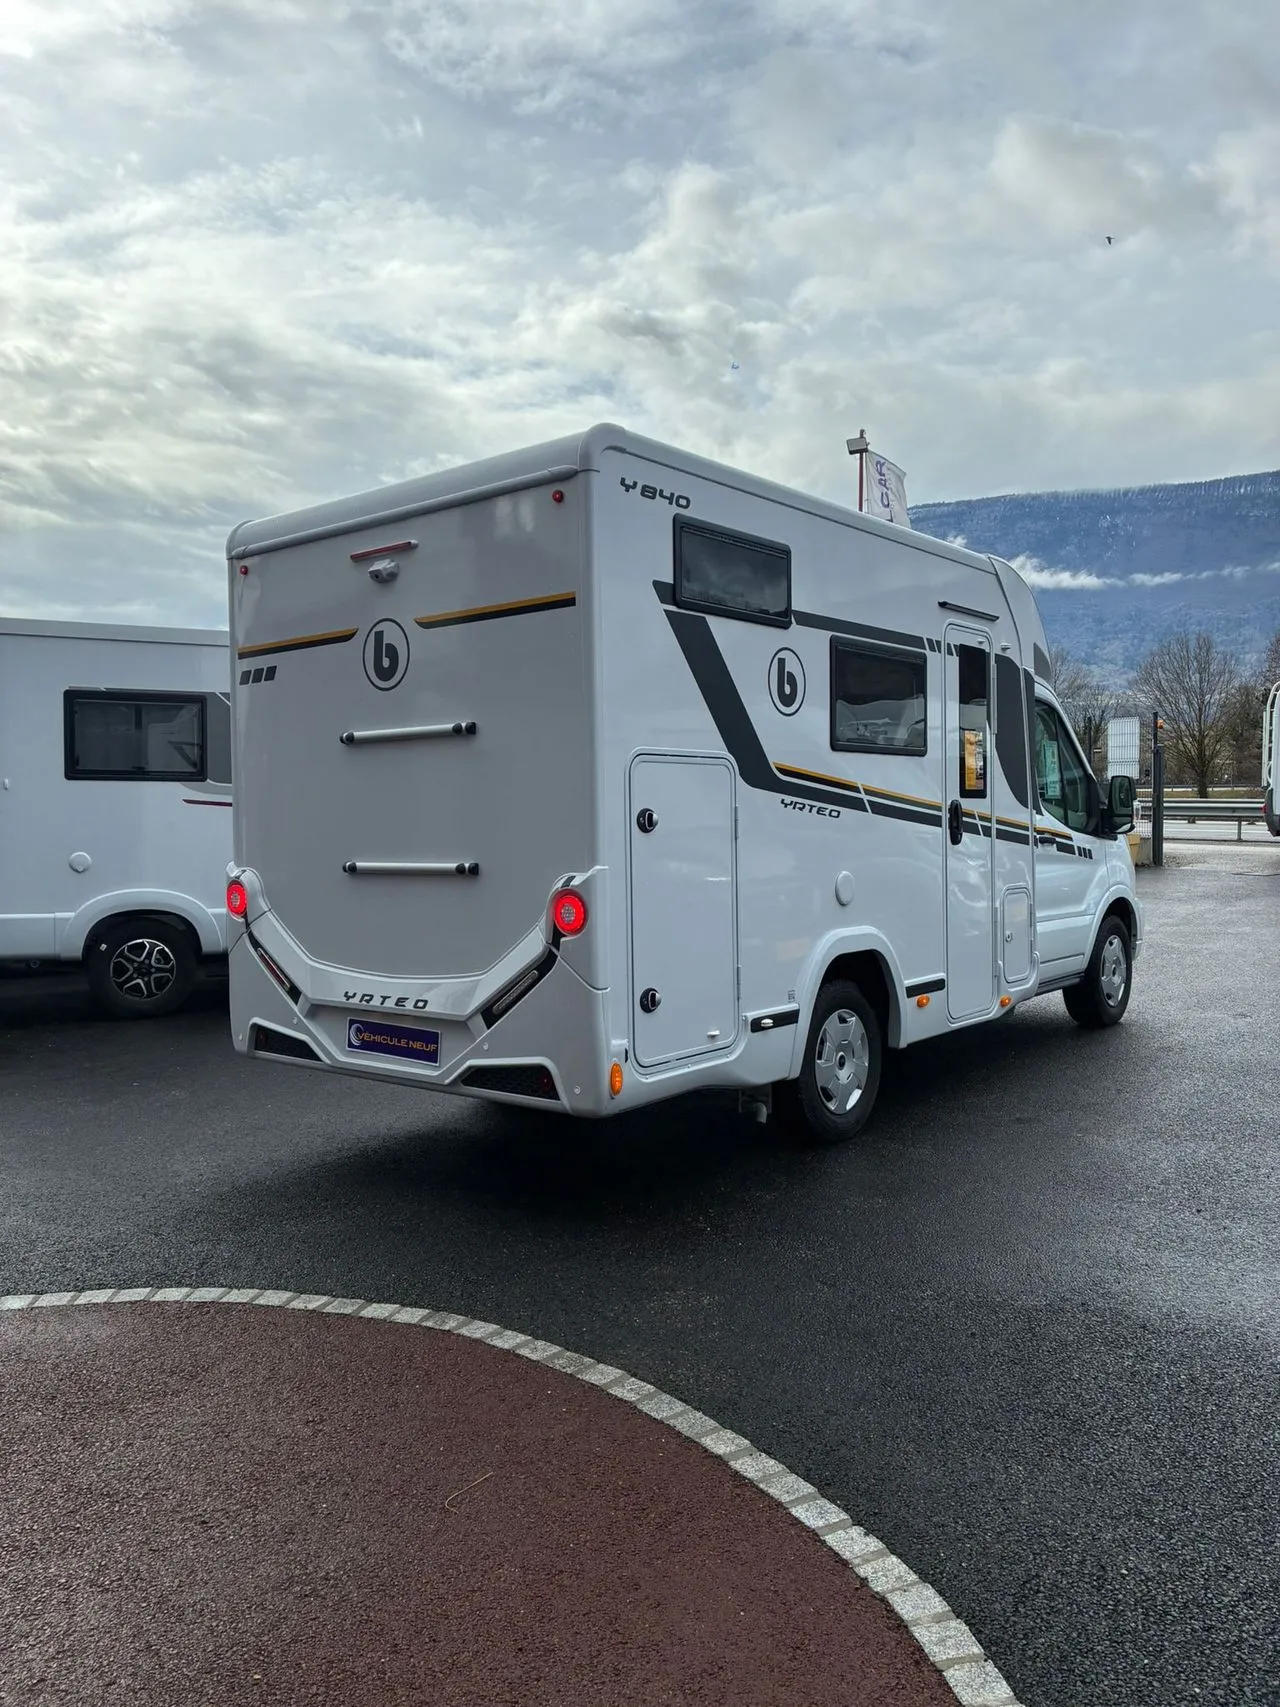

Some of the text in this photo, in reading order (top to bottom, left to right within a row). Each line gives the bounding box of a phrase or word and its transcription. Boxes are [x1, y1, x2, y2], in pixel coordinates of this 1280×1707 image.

[780, 798, 841, 819] YRTEO
[343, 991, 429, 1010] YRTEO
[408, 1040, 438, 1053] NEUF
